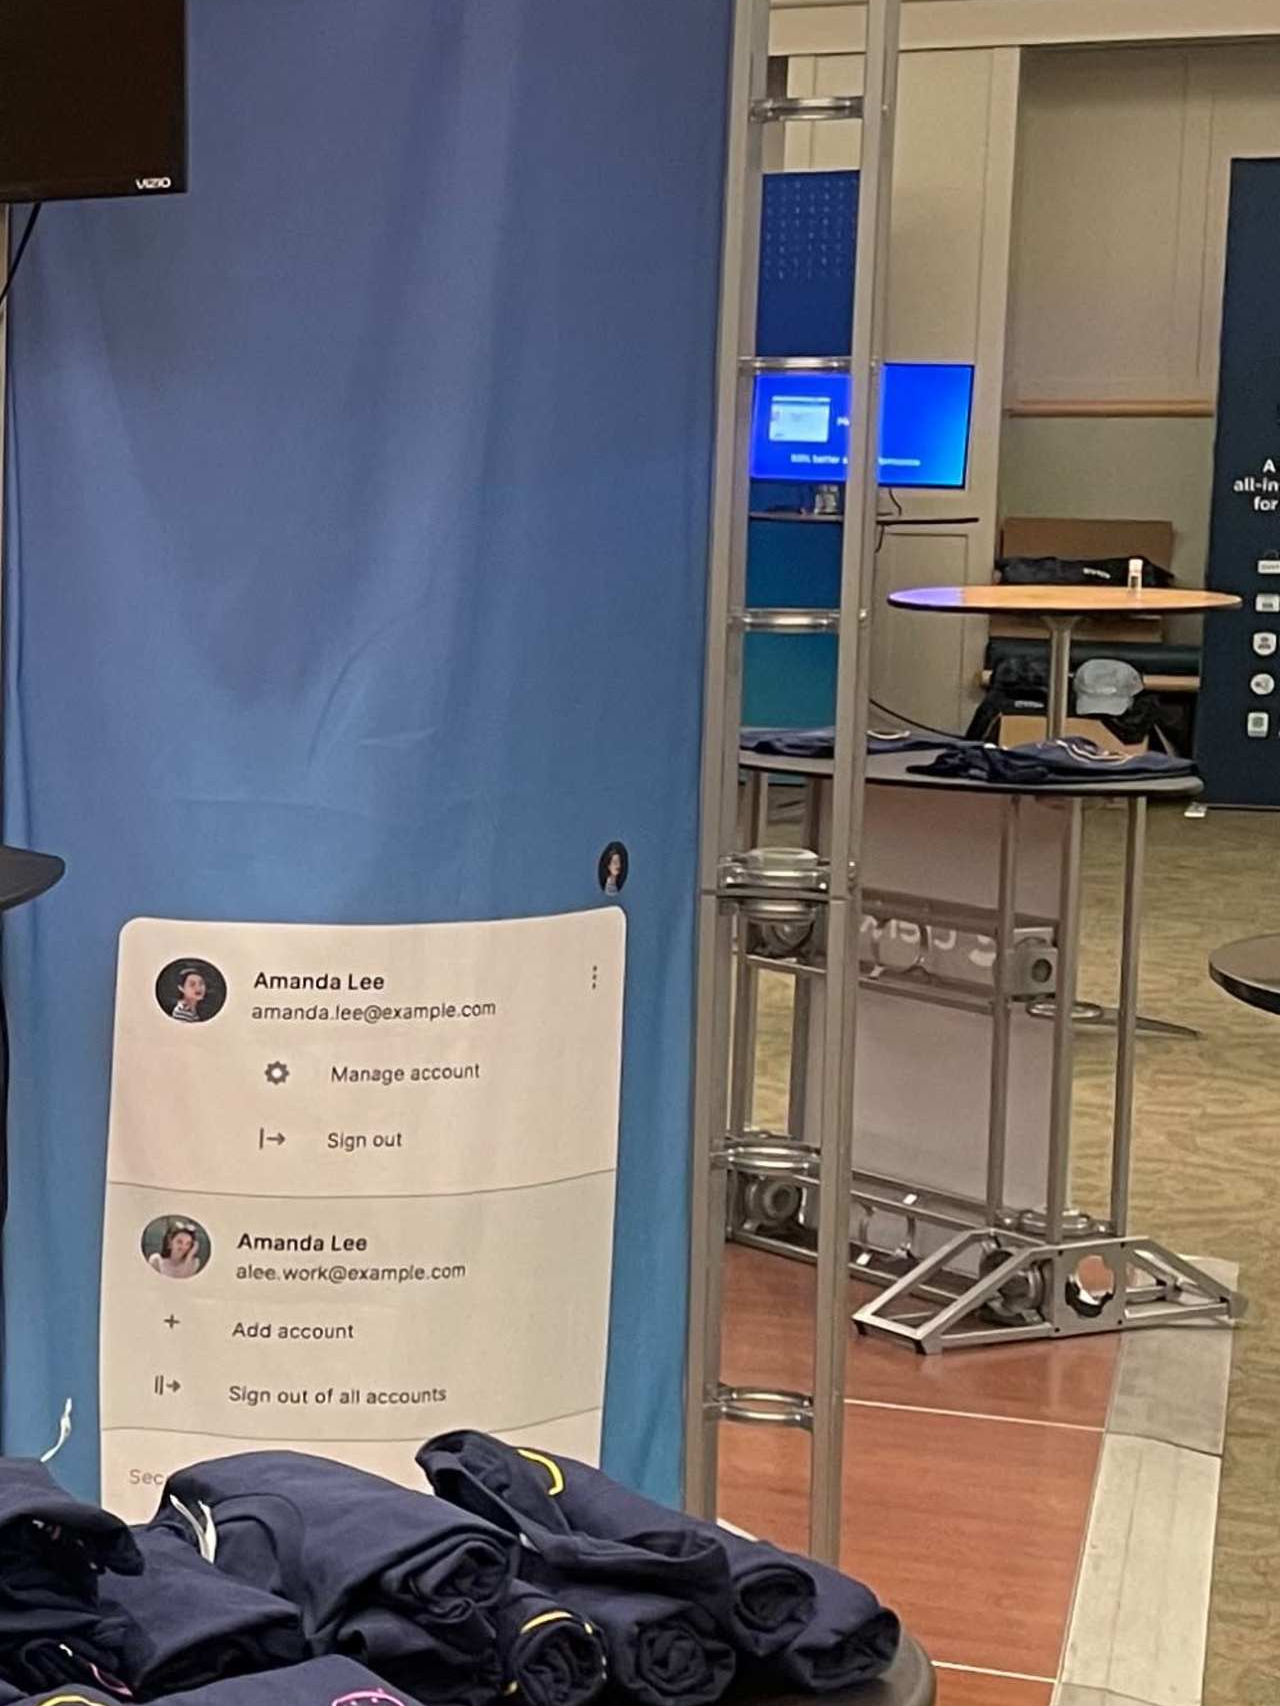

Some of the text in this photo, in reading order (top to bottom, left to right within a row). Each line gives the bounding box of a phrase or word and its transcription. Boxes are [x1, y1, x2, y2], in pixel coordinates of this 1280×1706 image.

[135, 176, 172, 190] VIZIO
[1263, 458, 1276, 473] A
[1253, 495, 1279, 511] for
[253, 971, 385, 991] Amanda Lee
[251, 1001, 497, 1025] amanda.lee@example.com
[330, 1063, 481, 1086] Manage account
[327, 1132, 403, 1153] Sign out
[237, 1232, 368, 1253] Amanda Lee
[236, 1263, 467, 1284] alee.work@example.com
[232, 1322, 354, 1340] Add account
[228, 1385, 447, 1407] Sign out of all accounts
